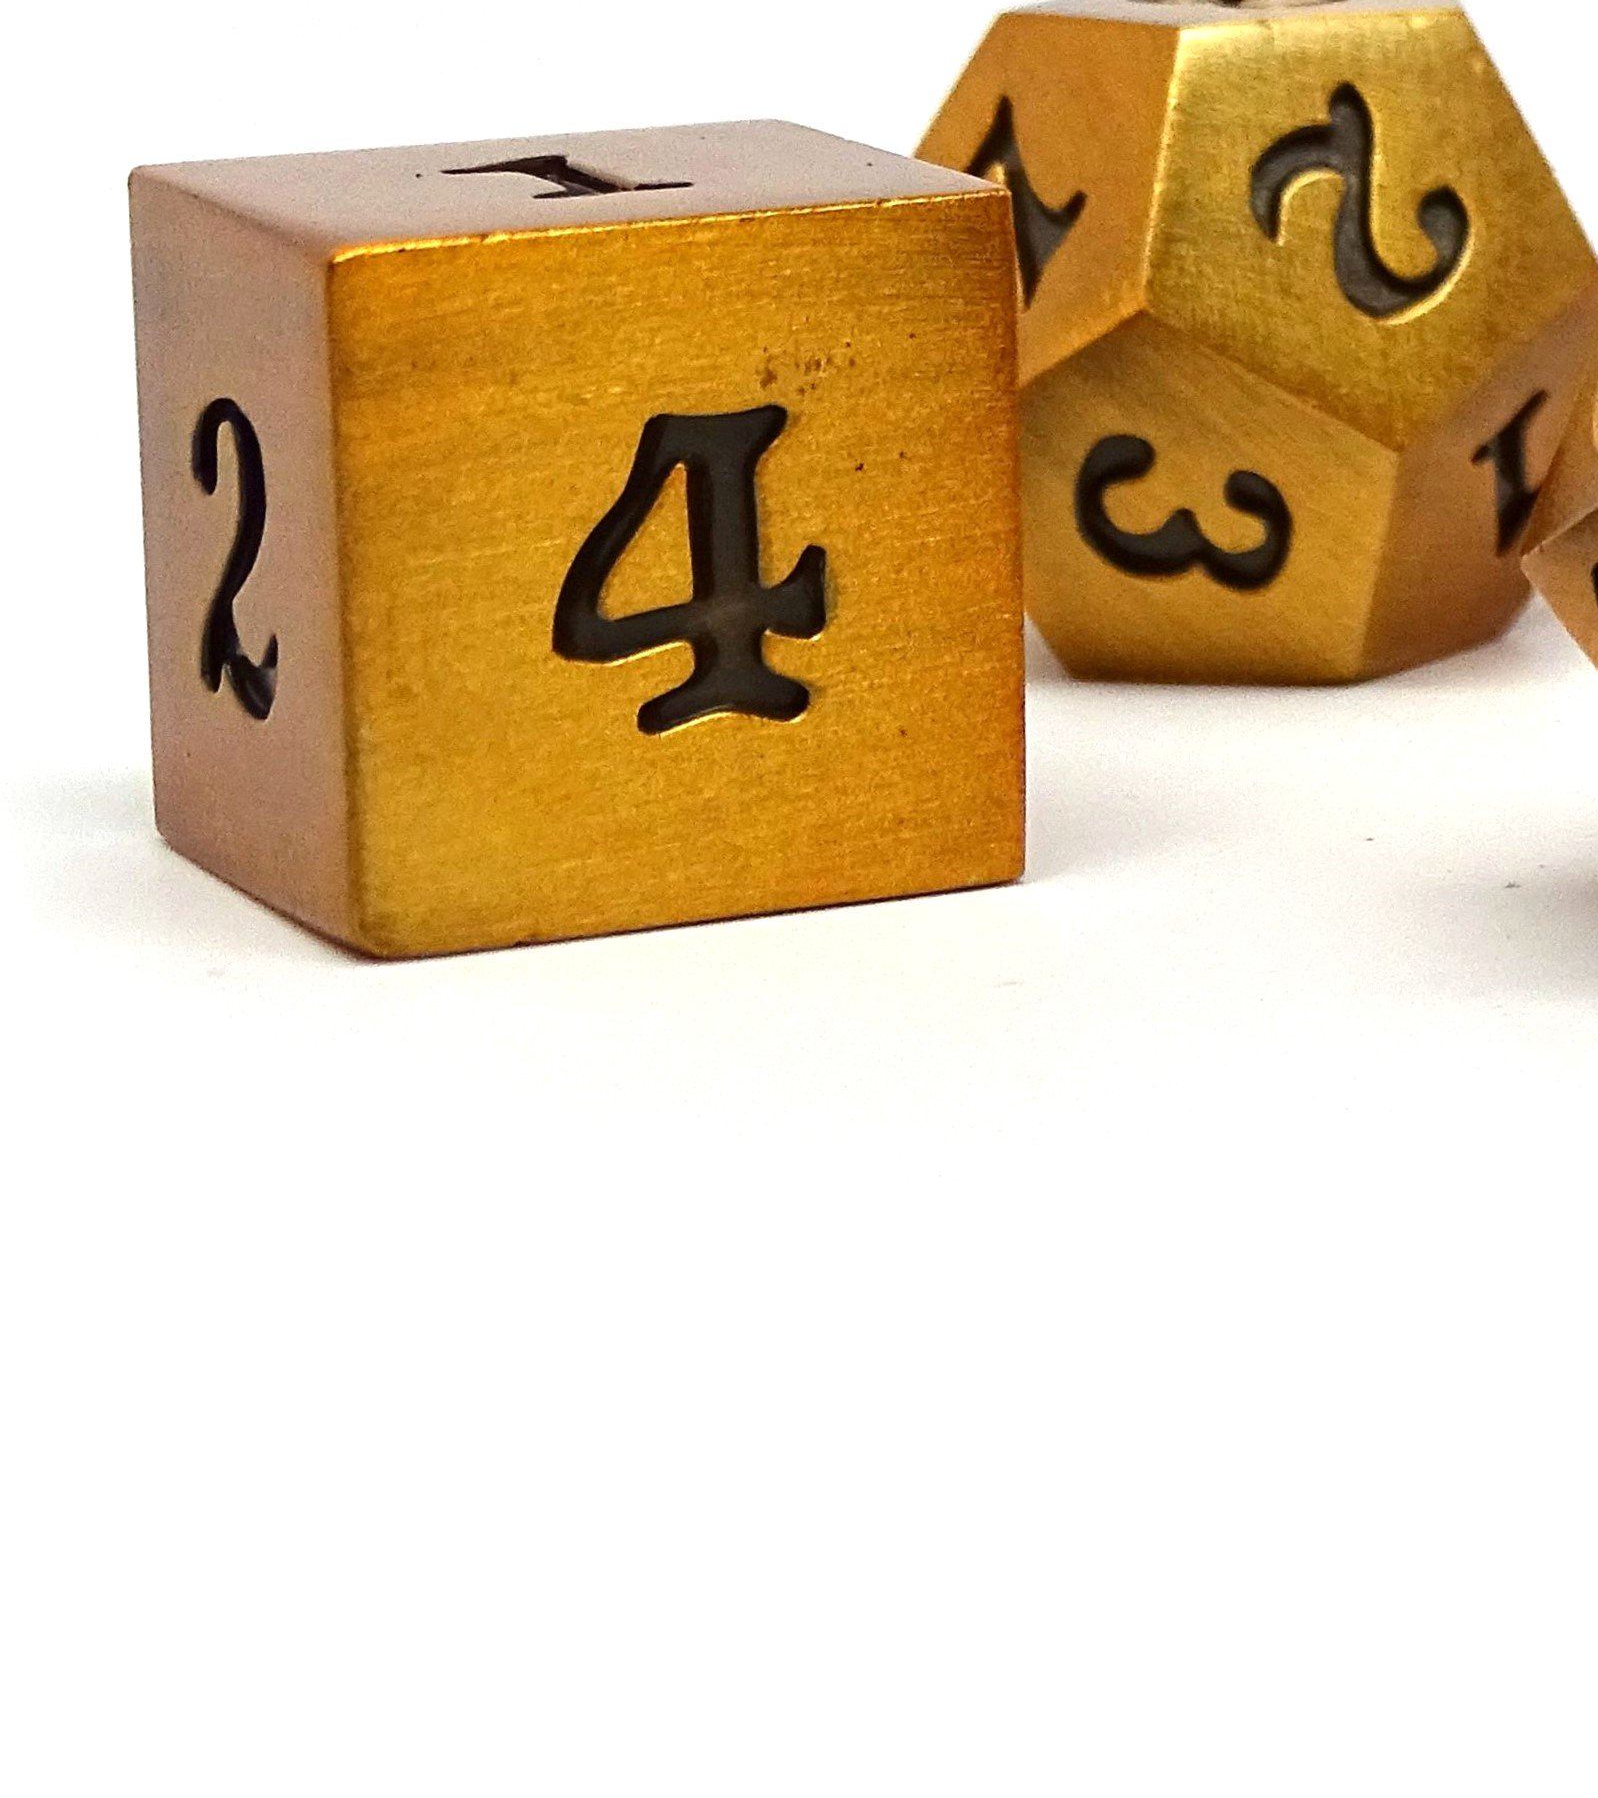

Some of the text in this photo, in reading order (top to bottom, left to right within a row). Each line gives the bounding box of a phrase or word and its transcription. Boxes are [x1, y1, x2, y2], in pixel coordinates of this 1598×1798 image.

[440, 155, 693, 199] 1
[1250, 81, 1474, 324] 2
[192, 397, 278, 721] 2
[552, 403, 830, 736] 4
[1074, 433, 1293, 591] 3
